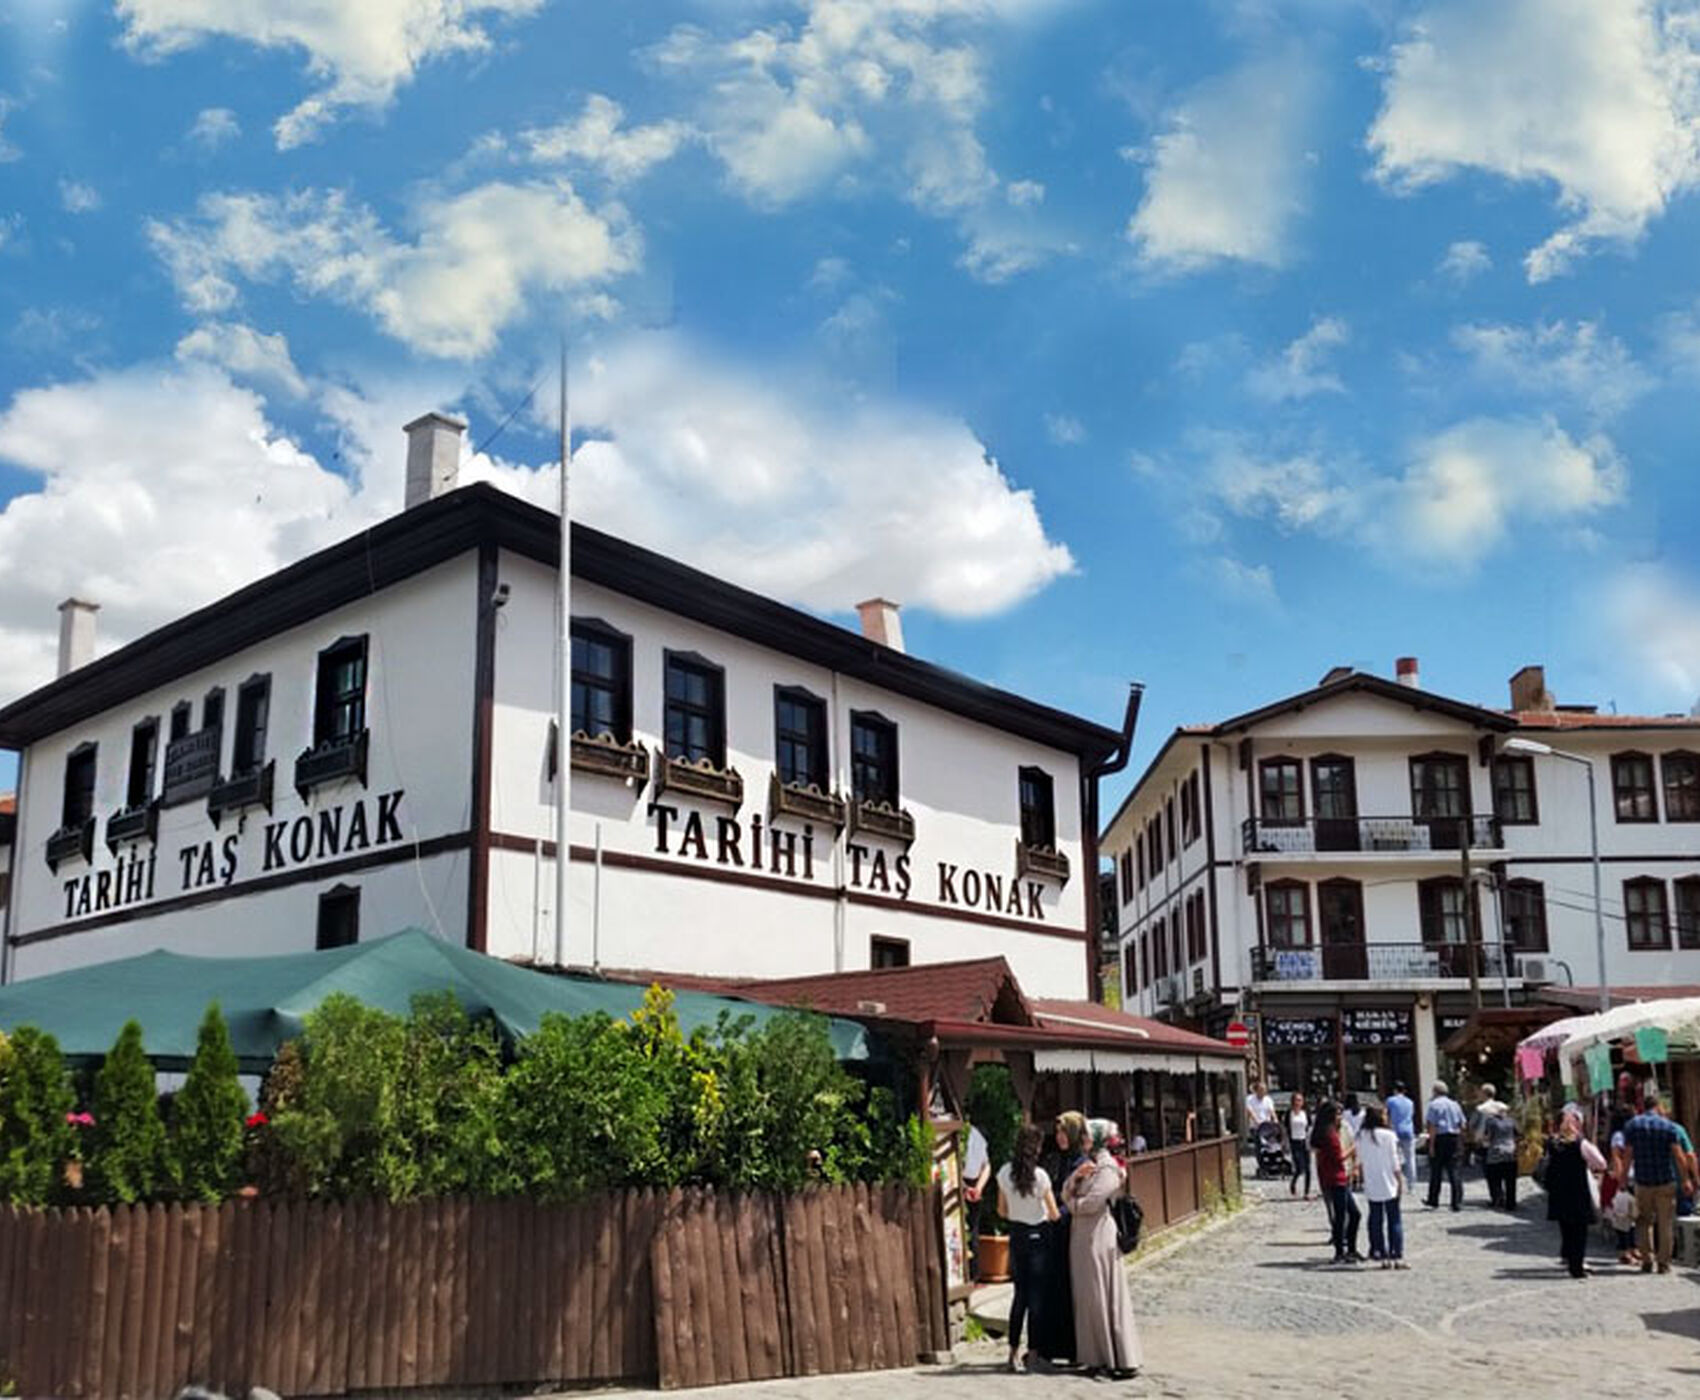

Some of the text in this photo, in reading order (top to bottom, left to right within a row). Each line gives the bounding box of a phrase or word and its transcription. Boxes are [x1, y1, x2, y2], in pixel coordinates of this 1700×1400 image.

[179, 834, 239, 891] TAŞ
[262, 790, 404, 871] KONAK
[647, 802, 1045, 920] TARİHİ TAŞ KONAK
